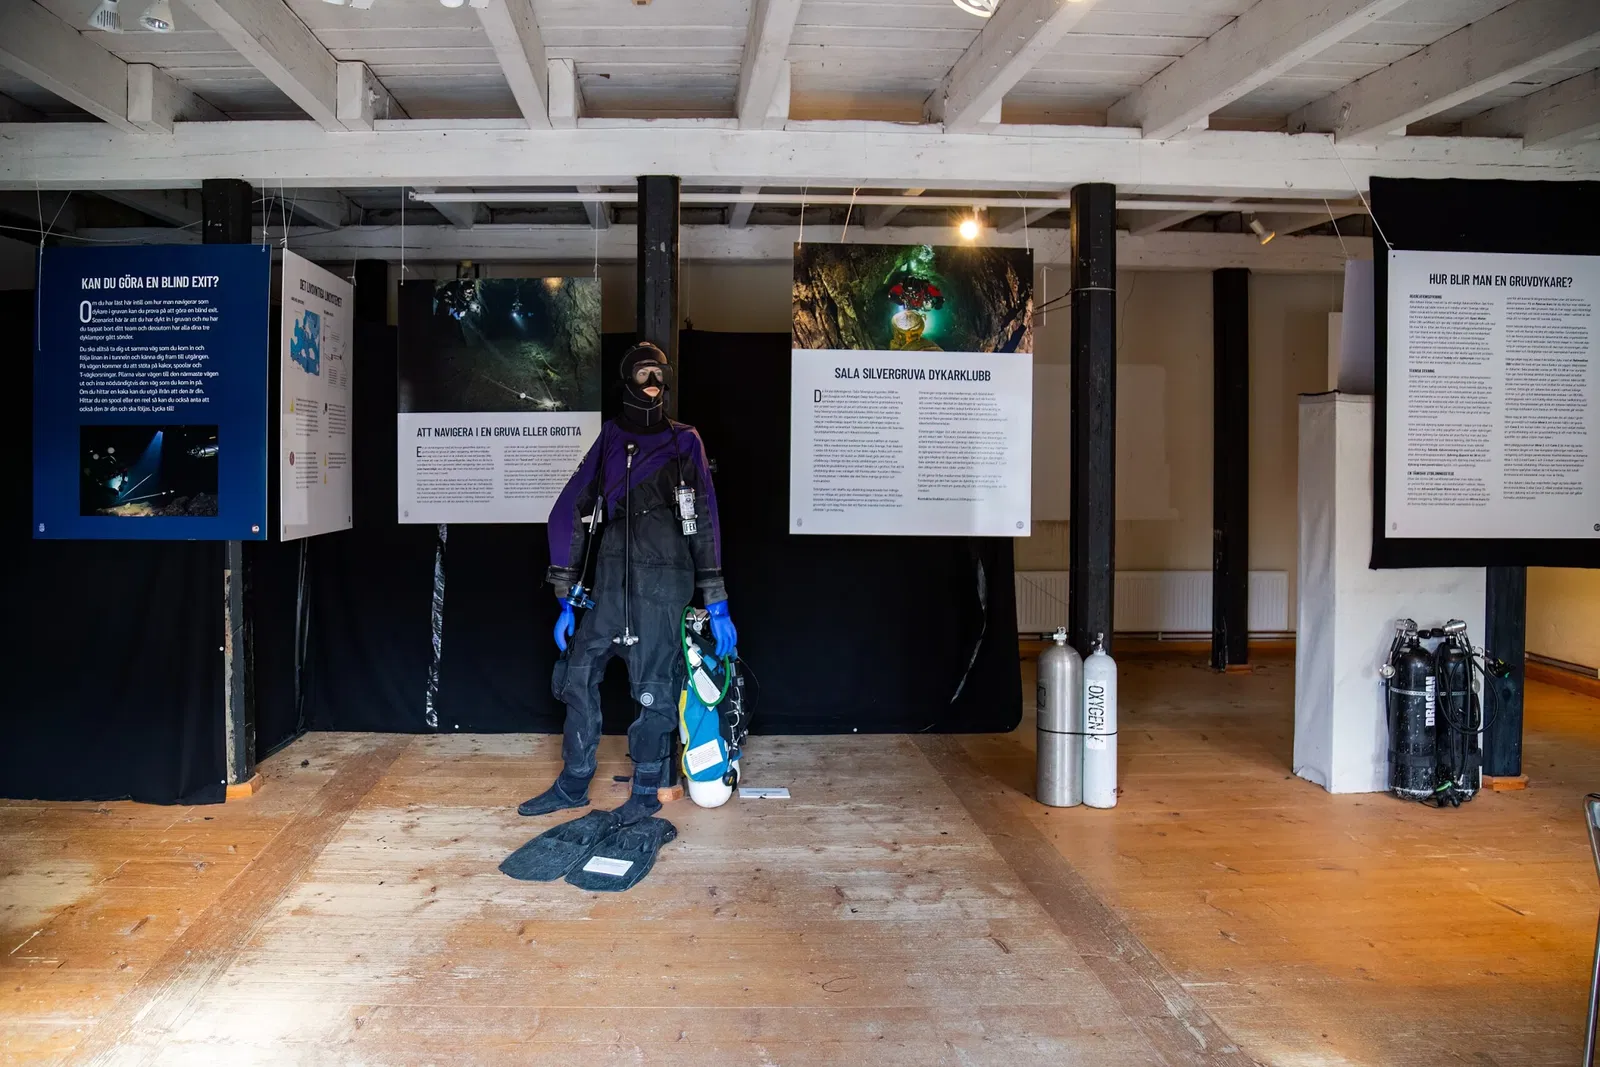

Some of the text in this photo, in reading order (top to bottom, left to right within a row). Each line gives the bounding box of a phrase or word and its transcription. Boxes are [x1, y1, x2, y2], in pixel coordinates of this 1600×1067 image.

[82, 274, 219, 289] KAN DU GÖRA EN BLIND EXIT?
[1430, 274, 1573, 288] HUR BLIR MAN EN GRUVDYKARE?
[835, 368, 991, 381] SALA SILVERGRUVA DYKARKLUBB
[417, 426, 581, 437] ATT NAVIGERA I EN GRUVA ELLER GROTTA
[1088, 685, 1104, 730] OXYGEN
